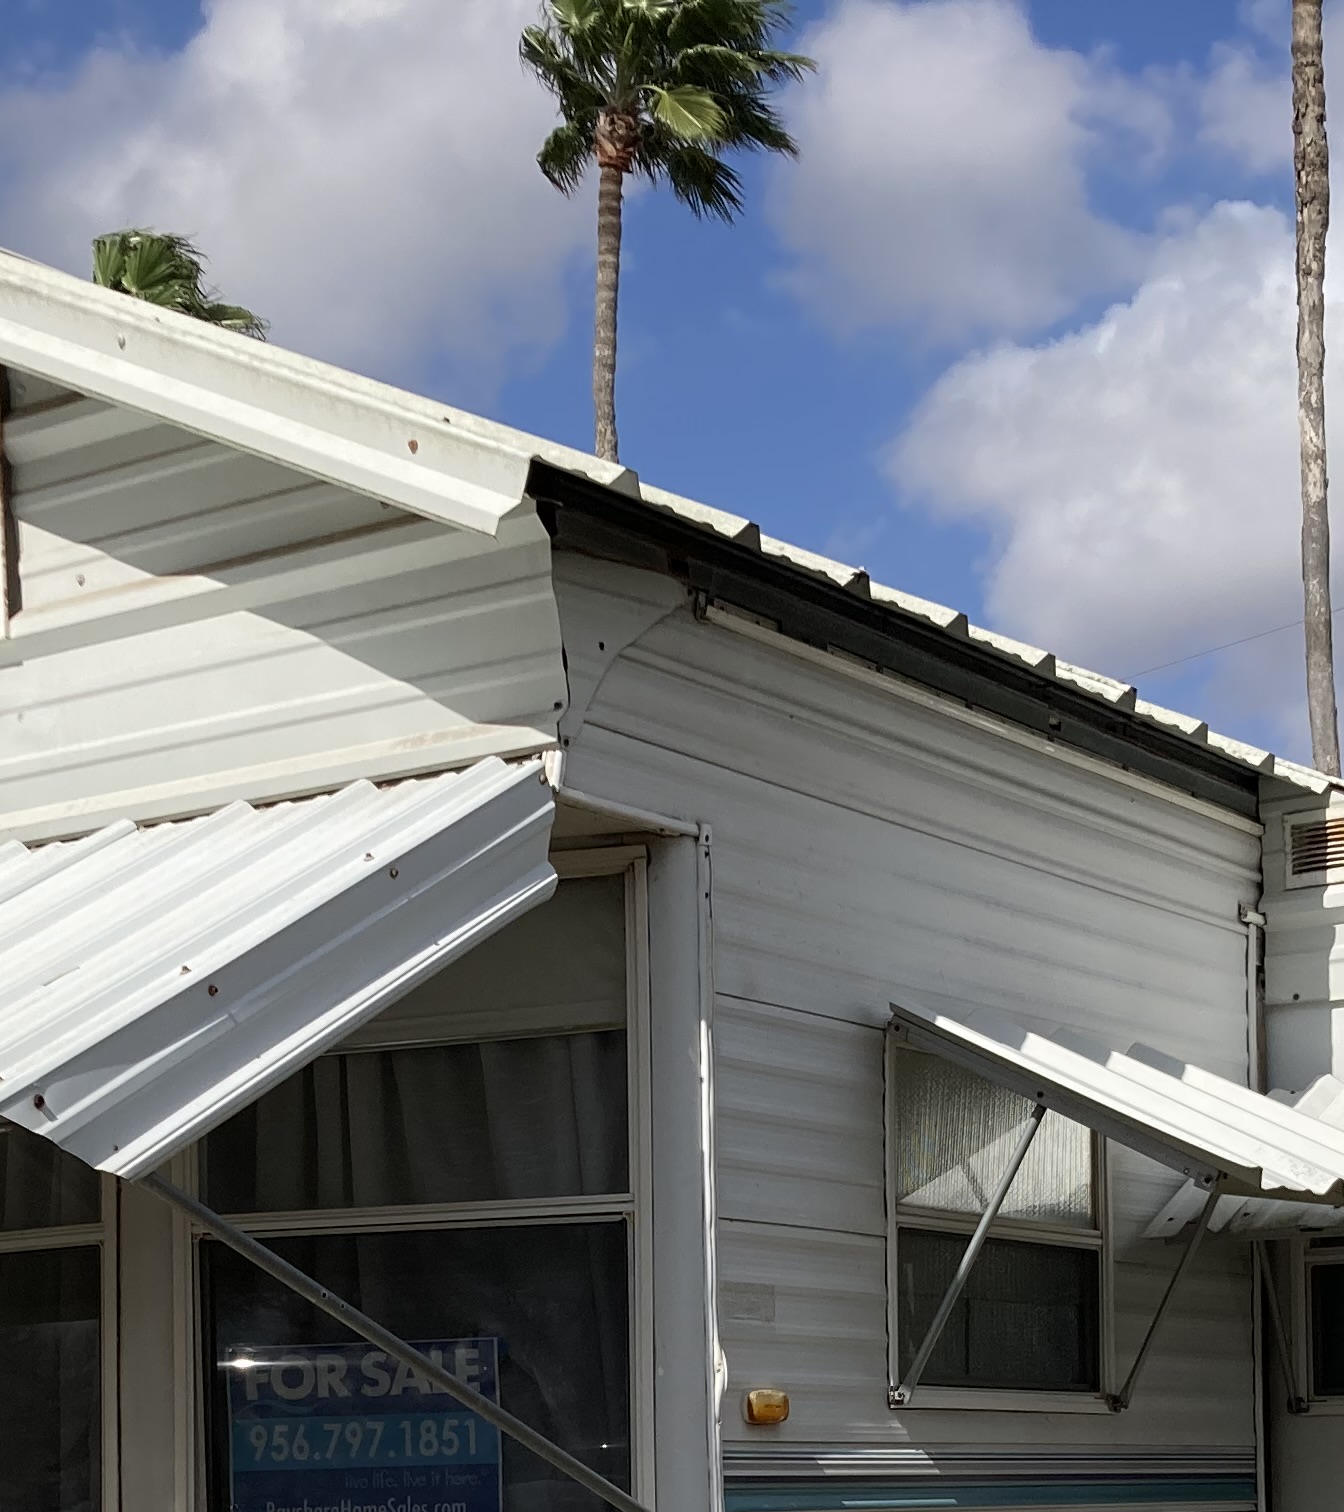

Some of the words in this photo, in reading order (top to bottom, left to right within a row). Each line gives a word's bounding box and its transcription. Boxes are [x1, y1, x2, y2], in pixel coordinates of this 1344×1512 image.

[242, 1353, 352, 1401] FOR
[360, 1347, 481, 1398] SALE
[249, 1418, 478, 1462] 956.797.1851
[403, 1467, 427, 1488] live
[431, 1469, 441, 1488] it
